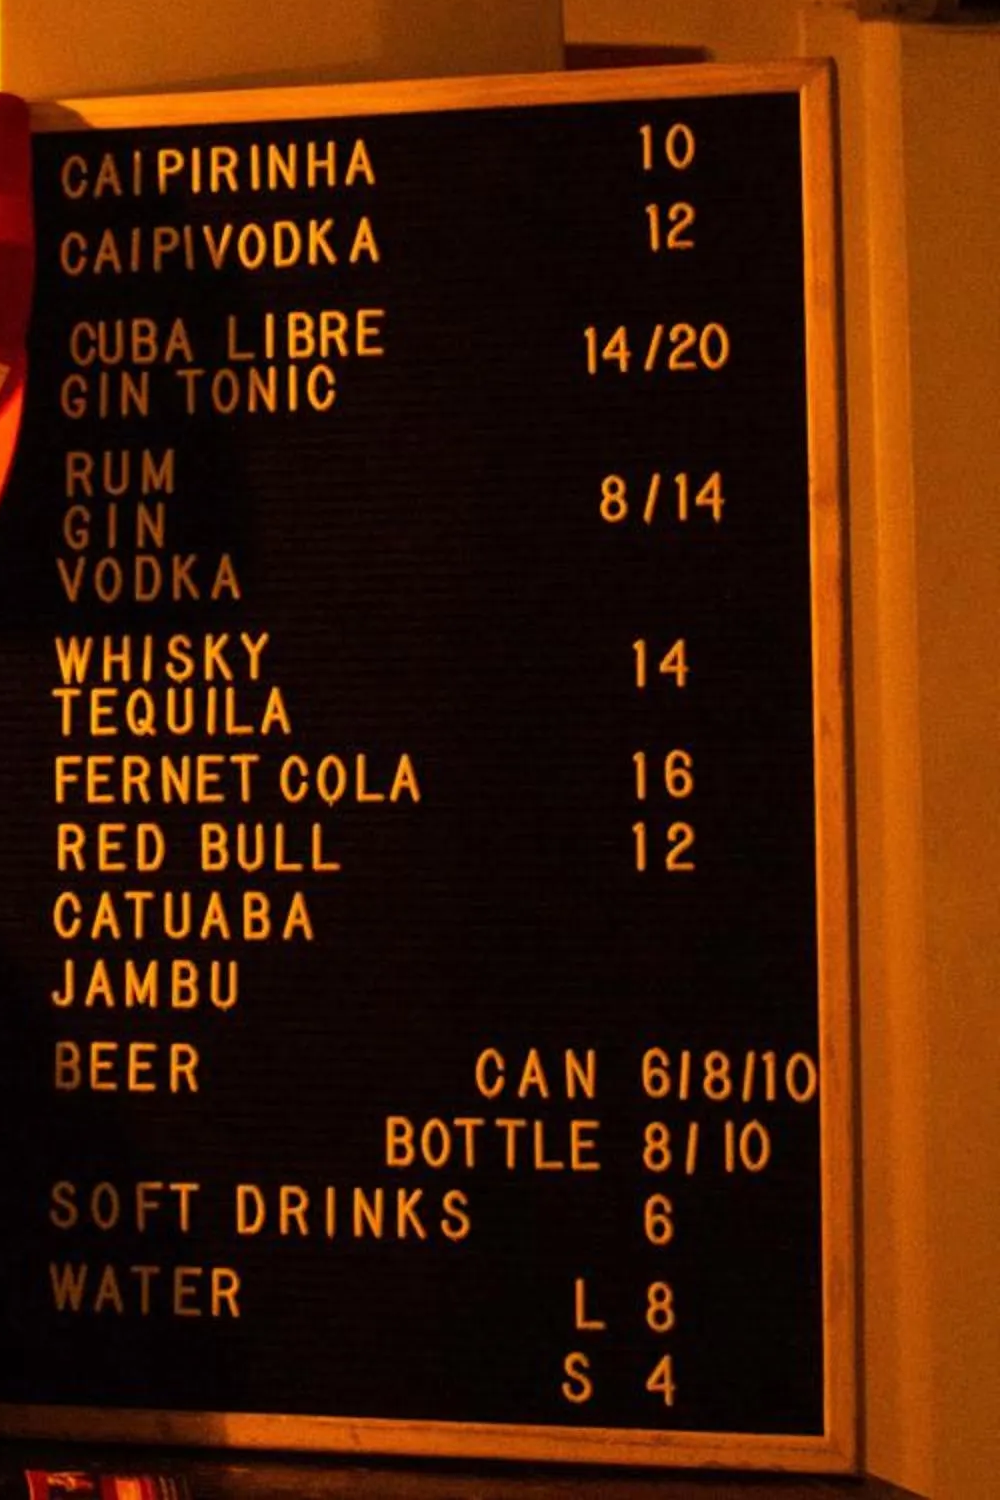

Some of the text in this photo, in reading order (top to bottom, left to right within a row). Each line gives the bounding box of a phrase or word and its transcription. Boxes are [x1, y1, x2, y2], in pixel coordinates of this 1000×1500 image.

[61, 122, 695, 198] CAIPIRINHA 10
[60, 201, 696, 275] CAIPIVODKA 12
[71, 308, 385, 366] CUBA LIBRE
[61, 362, 336, 418] GIN TONIC
[67, 449, 173, 496] RUM
[64, 503, 164, 550] GIN
[57, 554, 241, 603] VODKA
[55, 631, 689, 689] WHISKY 14
[51, 685, 291, 737] TEQUILA
[54, 749, 694, 807] FERNET COLA 16
[57, 821, 695, 873] RED BULL 12
[52, 890, 314, 941] CATUABA
[51, 958, 238, 1011] JAMBU
[56, 1041, 199, 1093] BEER
[475, 1047, 596, 1100] CAN
[385, 1115, 600, 1171] BOTTLE
[52, 1182, 674, 1246] SOFT DRINKS 6
[51, 1266, 675, 1332] WATER L 8
[561, 1351, 675, 1406] S 4
